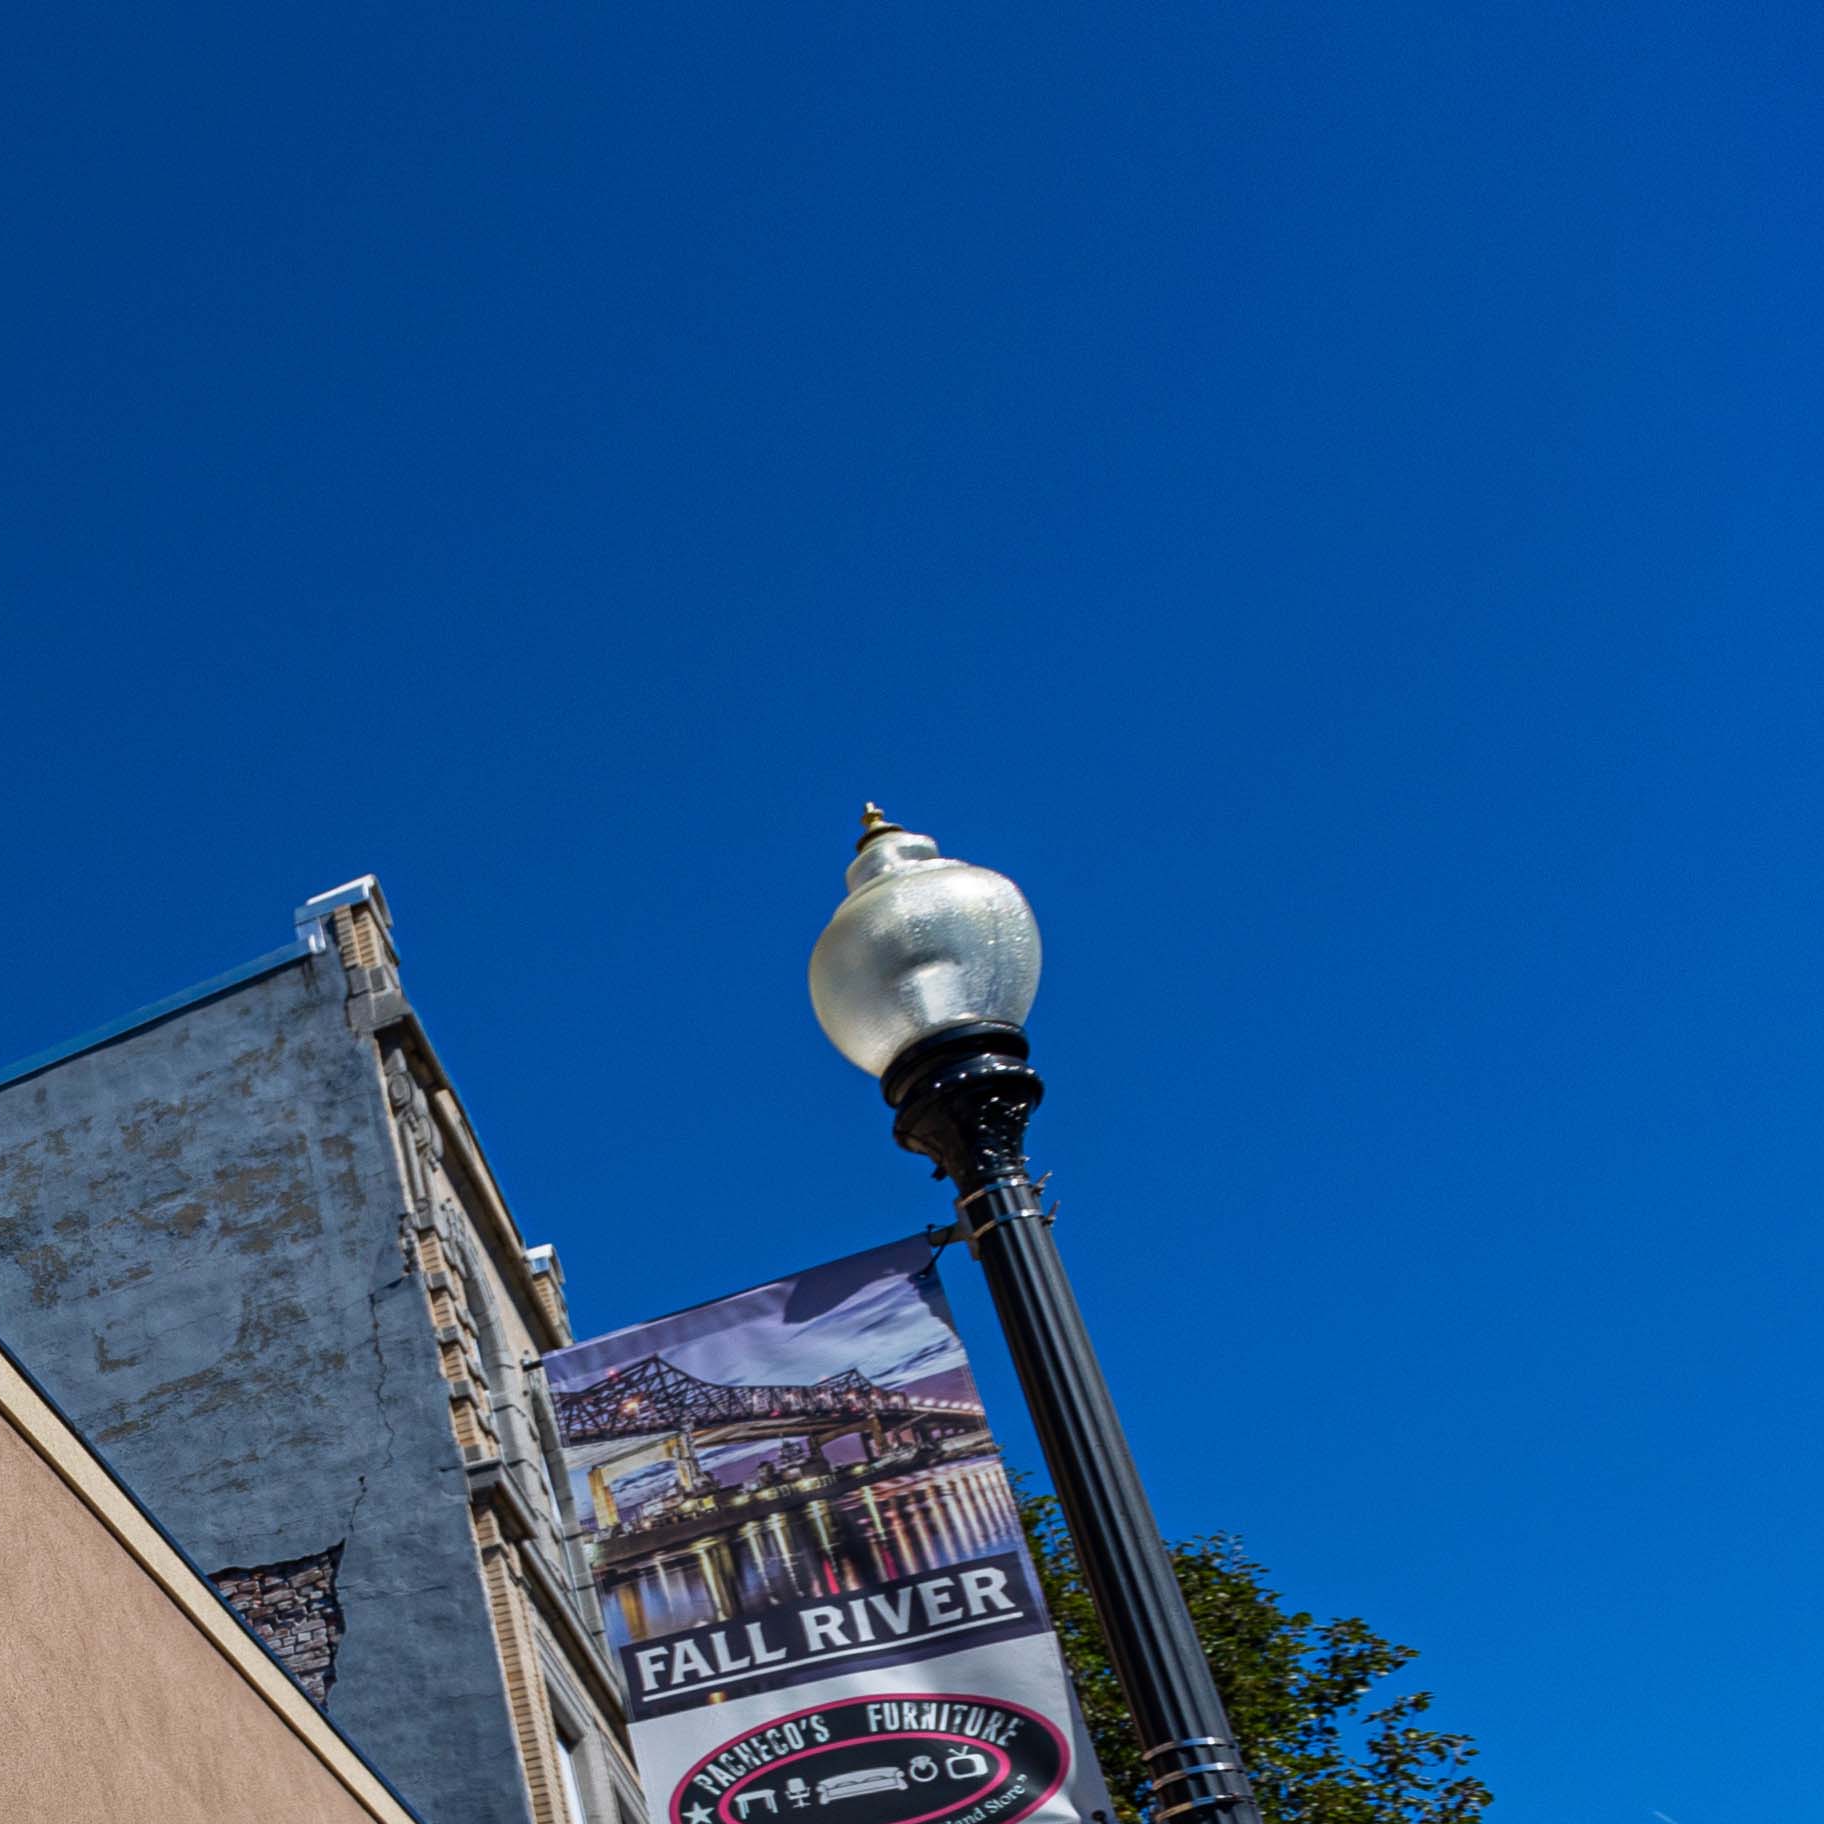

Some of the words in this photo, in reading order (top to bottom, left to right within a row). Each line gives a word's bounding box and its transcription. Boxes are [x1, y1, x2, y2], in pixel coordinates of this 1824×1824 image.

[635, 1621, 787, 1692] FALL
[798, 1566, 1016, 1652] RIVER
[693, 1714, 830, 1795] PACHECO'S
[866, 1702, 1025, 1747] FURNITURE
